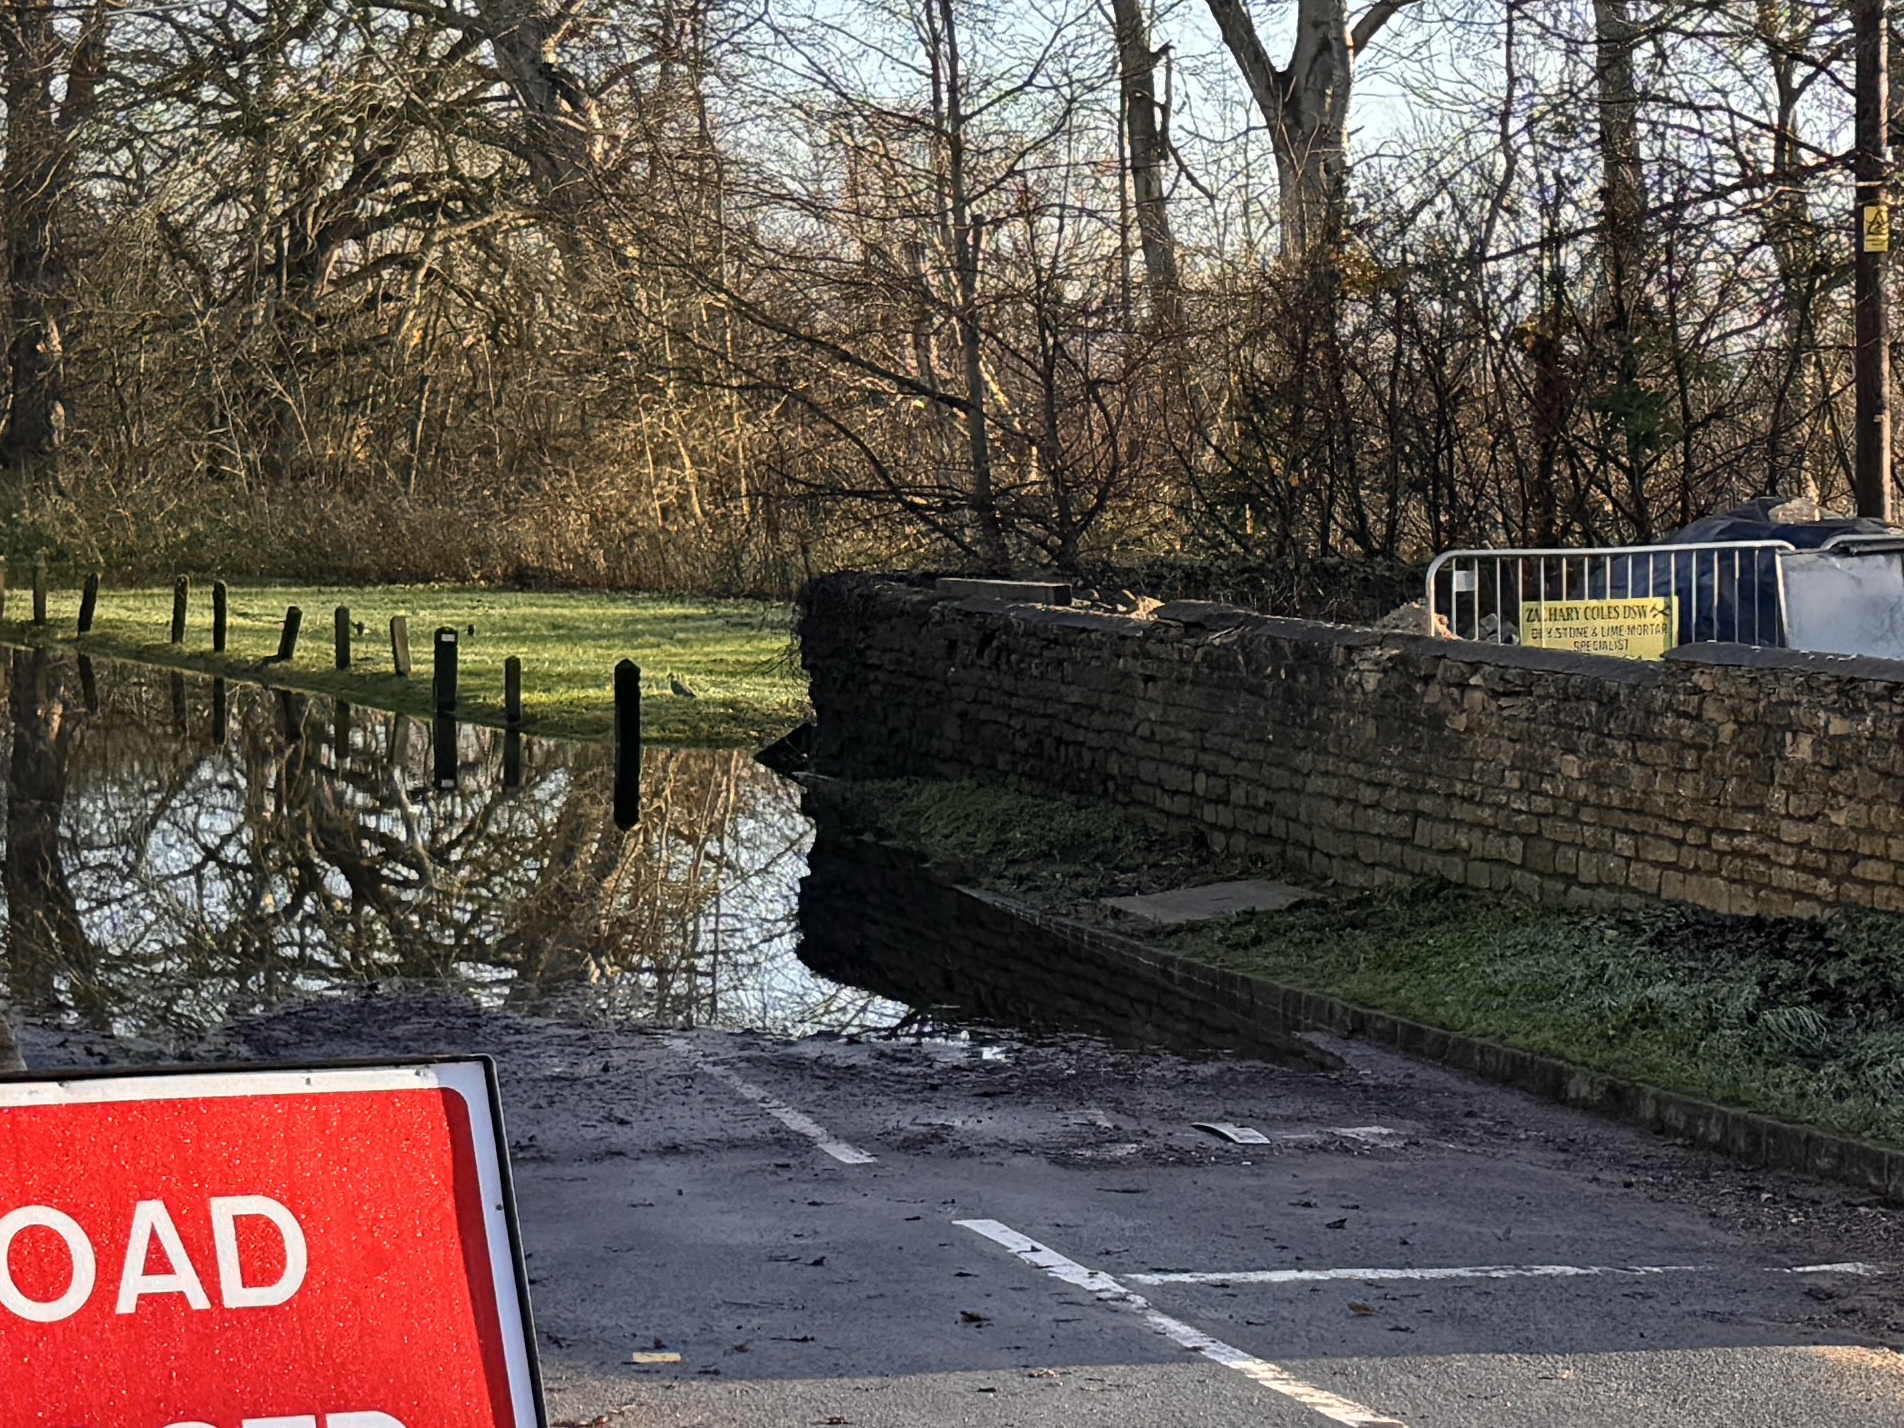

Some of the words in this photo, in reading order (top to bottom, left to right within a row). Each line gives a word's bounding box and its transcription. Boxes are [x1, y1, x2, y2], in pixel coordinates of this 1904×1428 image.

[1584, 605, 1620, 620] COLES
[1623, 604, 1648, 619] DSW
[1554, 626, 1589, 639] STONE
[1601, 625, 1624, 638] LIME
[1626, 623, 1668, 636] MORTAR
[1573, 638, 1629, 652] SPECIALIST
